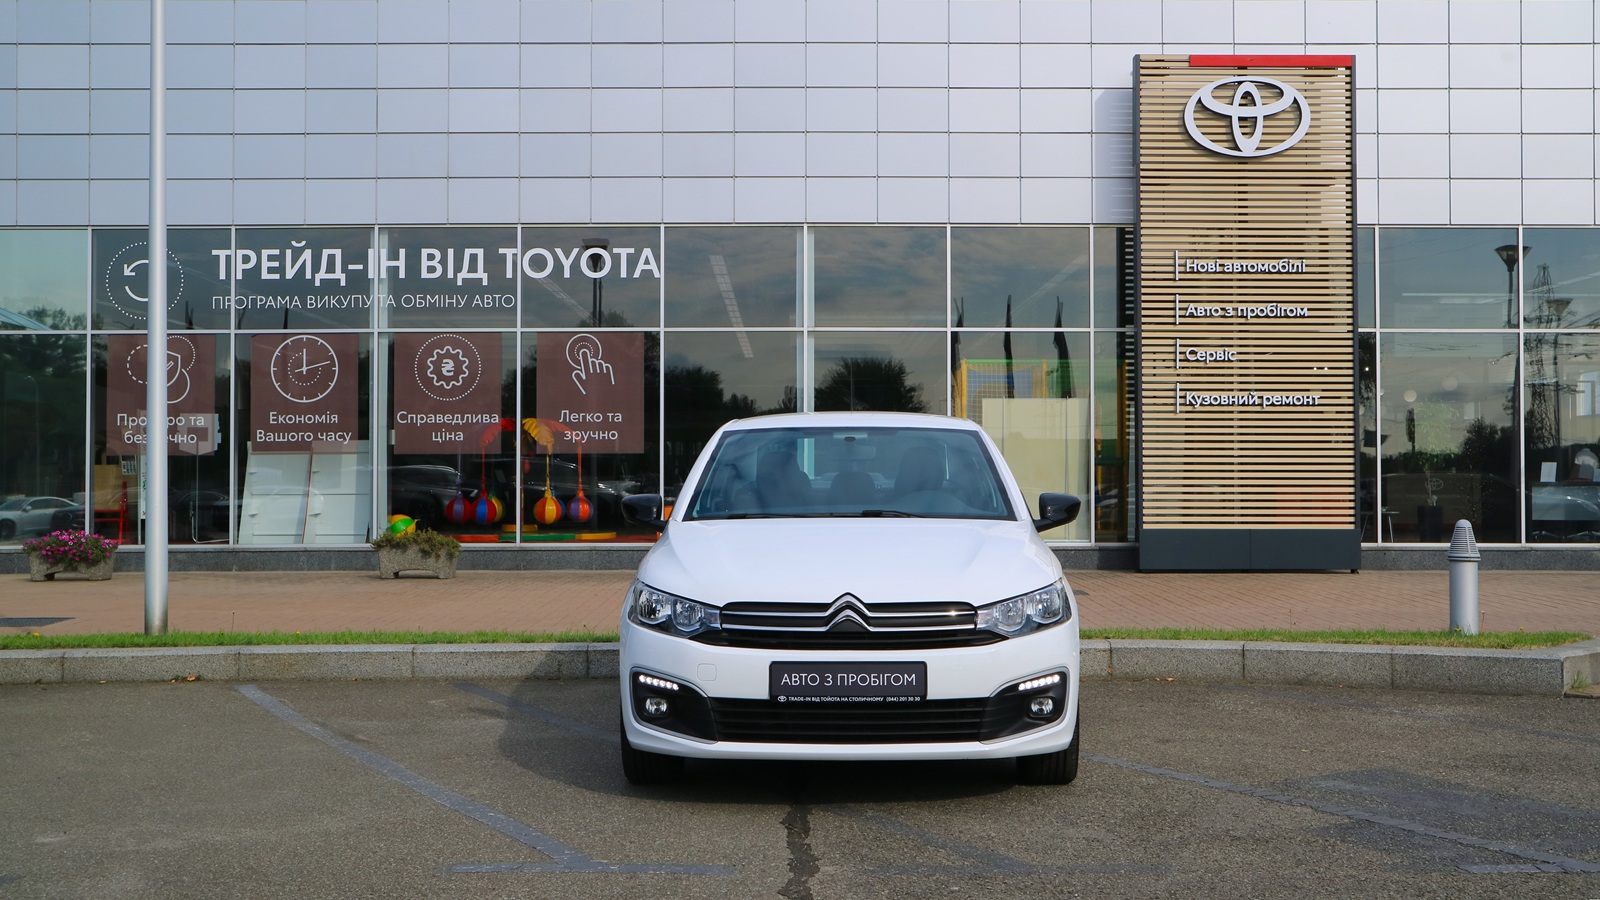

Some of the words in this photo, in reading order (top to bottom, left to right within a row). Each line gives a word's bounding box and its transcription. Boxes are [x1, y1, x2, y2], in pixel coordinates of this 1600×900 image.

[211, 240, 406, 286] ТРЕЙД-ІН
[420, 247, 488, 286] ВІД
[498, 247, 661, 279] TOYOTA
[1185, 258, 1220, 273] Нові
[1224, 258, 1306, 273] автомобілі
[212, 294, 302, 310] ПРОГРАМА
[307, 294, 374, 309] ВИКУПУ
[375, 294, 397, 308] ТА
[401, 293, 469, 308] ОБМІНУ
[472, 293, 515, 308] АВТО
[1185, 303, 1221, 317] Авто
[1224, 306, 1233, 317] з
[1237, 303, 1309, 320] пробігом
[1185, 347, 1237, 364] Сервіс
[1185, 391, 1259, 408] Кузовний
[1262, 394, 1321, 408] ремонт
[117, 413, 185, 429] Проро
[189, 416, 205, 426] та
[269, 411, 339, 425] Економія
[396, 411, 499, 426] Справедлива
[559, 410, 603, 423] Легко
[607, 412, 623, 423] та
[124, 430, 197, 444] безчно
[256, 429, 314, 442] Вашого
[318, 431, 352, 445] часу
[432, 428, 464, 442] ціна
[563, 430, 618, 443] зручно
[780, 673, 820, 686] АВТО
[824, 673, 833, 686] З
[837, 673, 916, 686] ПРОБІГОМ
